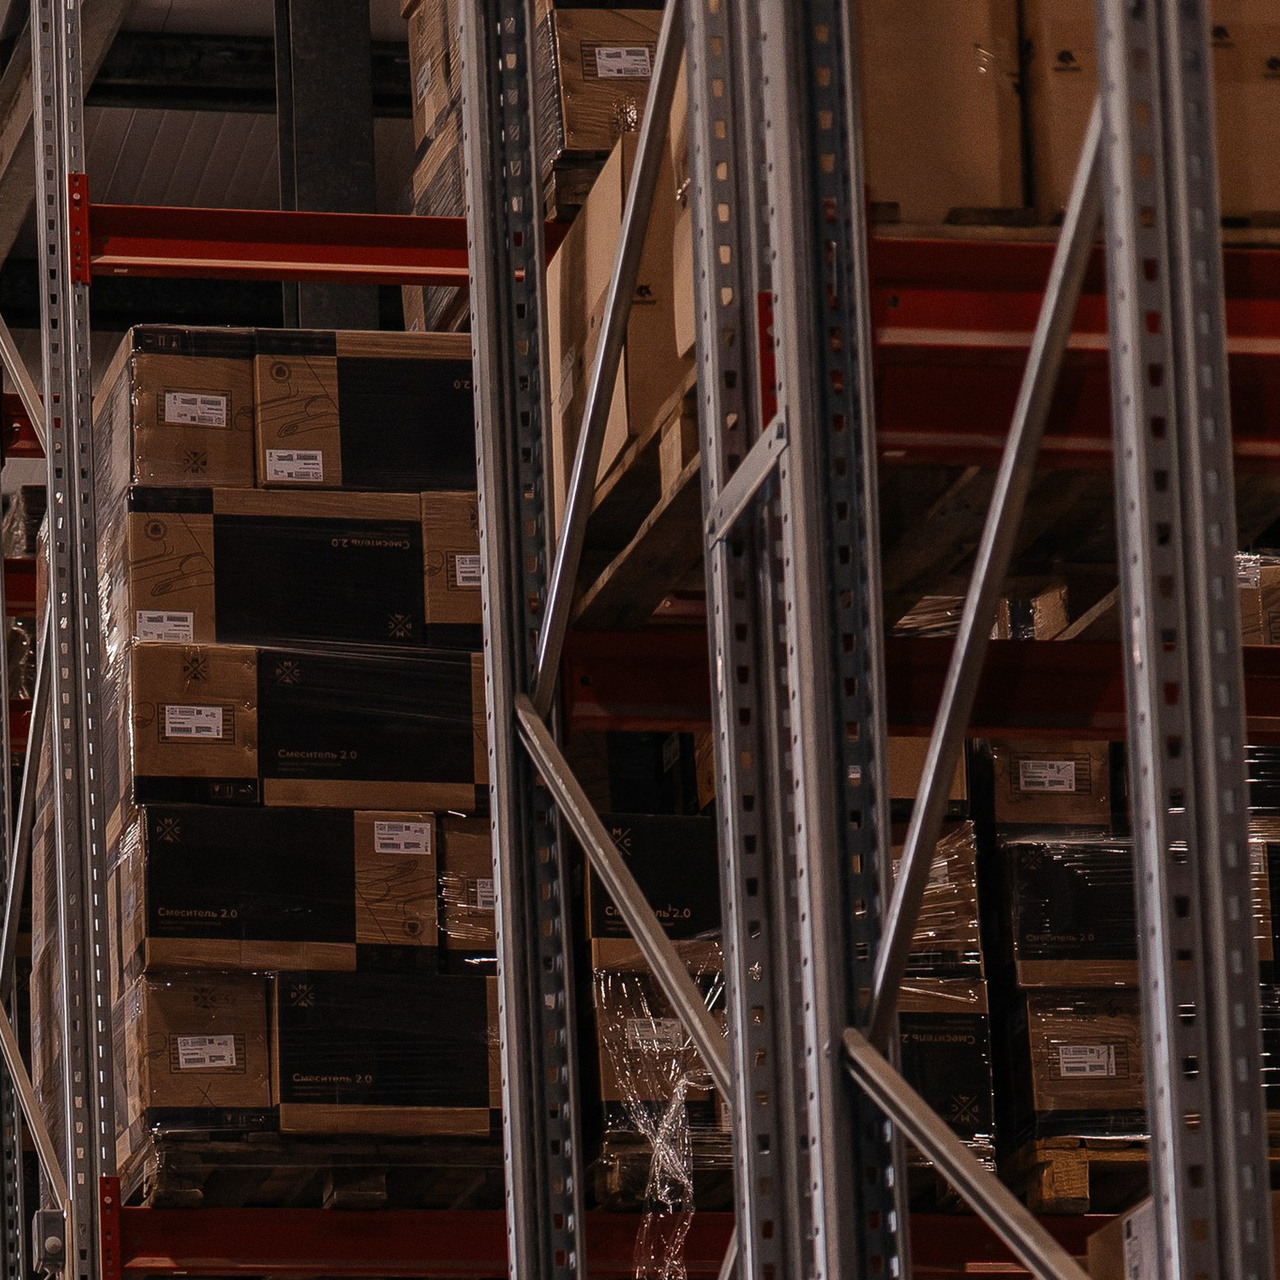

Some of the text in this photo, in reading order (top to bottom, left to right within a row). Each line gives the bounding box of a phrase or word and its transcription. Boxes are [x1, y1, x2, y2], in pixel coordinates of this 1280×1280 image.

[351, 539, 410, 549] Смеситель
[278, 750, 357, 760] Смеситель 2.0
[157, 907, 238, 918] Смеситель 2.0
[912, 1034, 975, 1045] Смеситель
[292, 1073, 372, 1084] Смеситель 2.0
